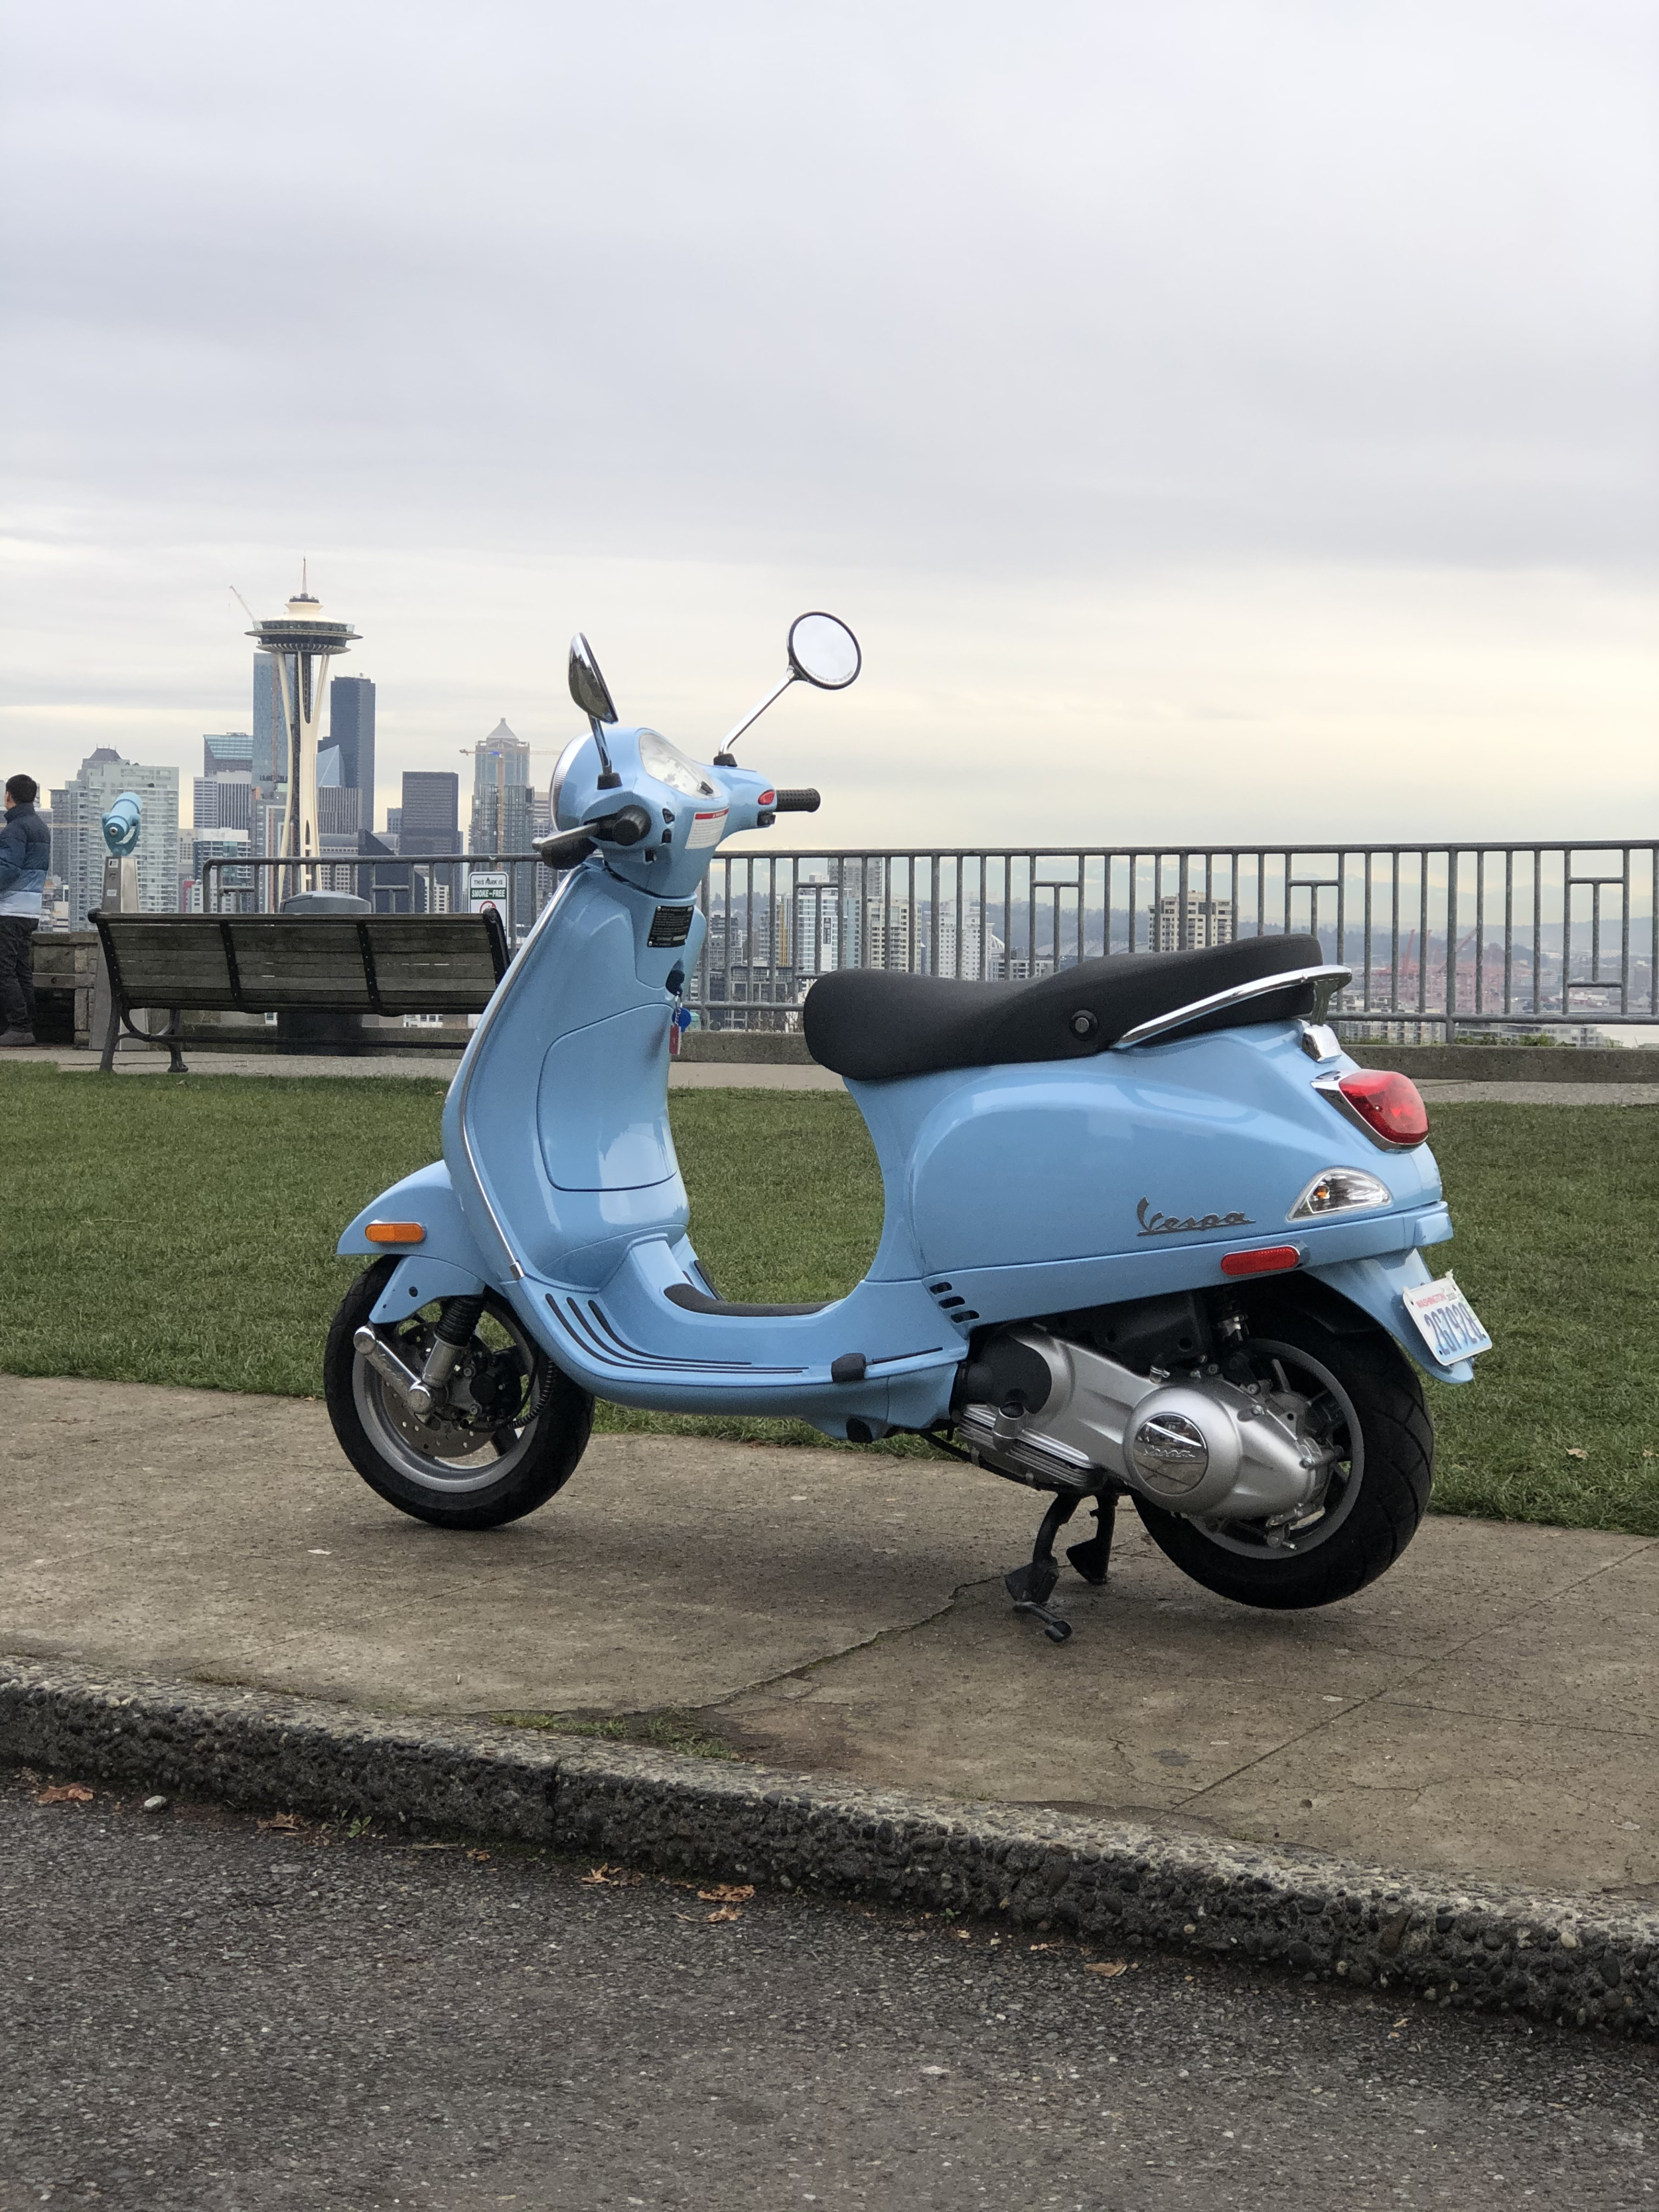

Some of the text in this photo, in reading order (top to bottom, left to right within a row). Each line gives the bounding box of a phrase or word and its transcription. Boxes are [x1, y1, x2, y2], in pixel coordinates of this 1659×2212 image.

[471, 889, 505, 898] SMOKE-FREE
[1137, 1195, 1256, 1236] Vespa
[1415, 1293, 1446, 1309] WASHINGTON
[1423, 1301, 1484, 1356] 2G7928
